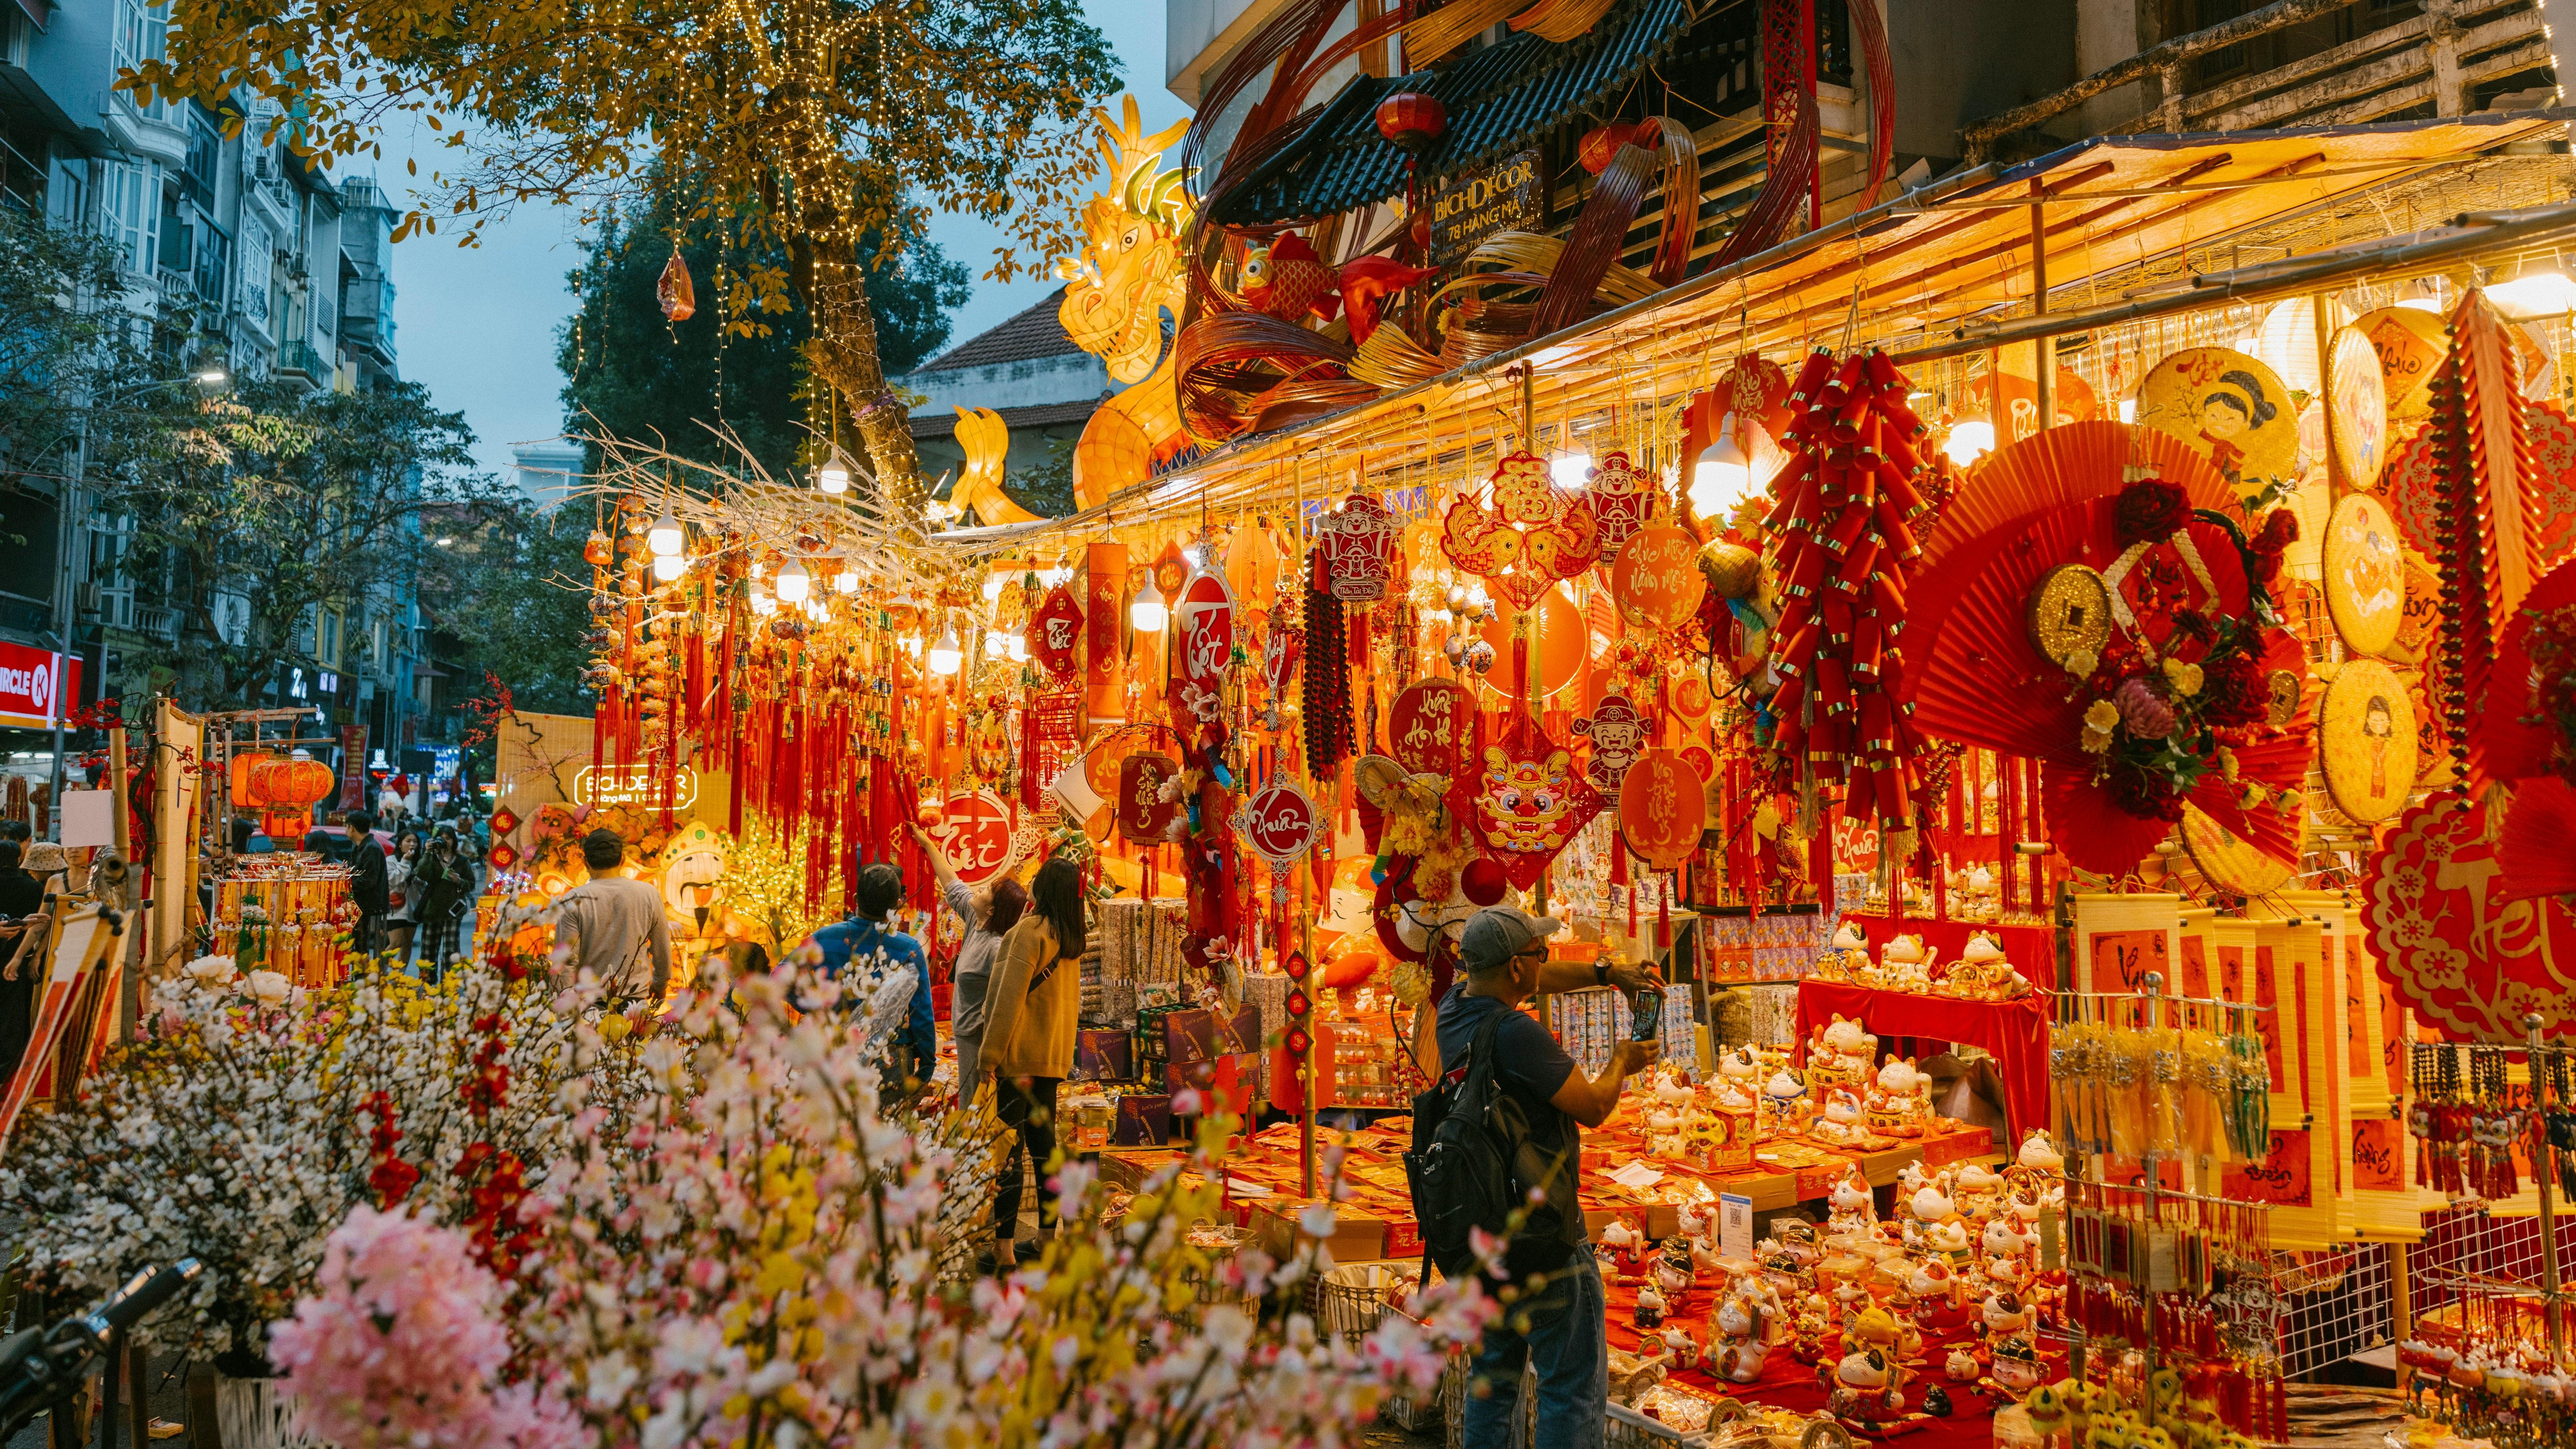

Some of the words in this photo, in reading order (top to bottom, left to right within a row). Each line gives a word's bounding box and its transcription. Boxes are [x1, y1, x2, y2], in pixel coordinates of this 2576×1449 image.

[1448, 224, 1461, 242] 78
[1463, 207, 1500, 235] HÀNG
[1502, 196, 1522, 219] MÃ
[1438, 251, 1454, 263] 0904
[1456, 243, 1467, 255] 766
[1469, 237, 1482, 249] 716
[2176, 353, 2224, 387] Tết
[1362, 586, 1374, 594] Đến
[2403, 586, 2439, 628] ăm
[1046, 618, 1072, 649] Tết
[1181, 601, 1231, 680] Tết
[0, 667, 31, 695] IRCLE
[34, 668, 48, 706] K
[1250, 789, 1311, 853] Xuân
[930, 815, 1005, 871] Tết
[1804, 1174, 1833, 1190] 花季
